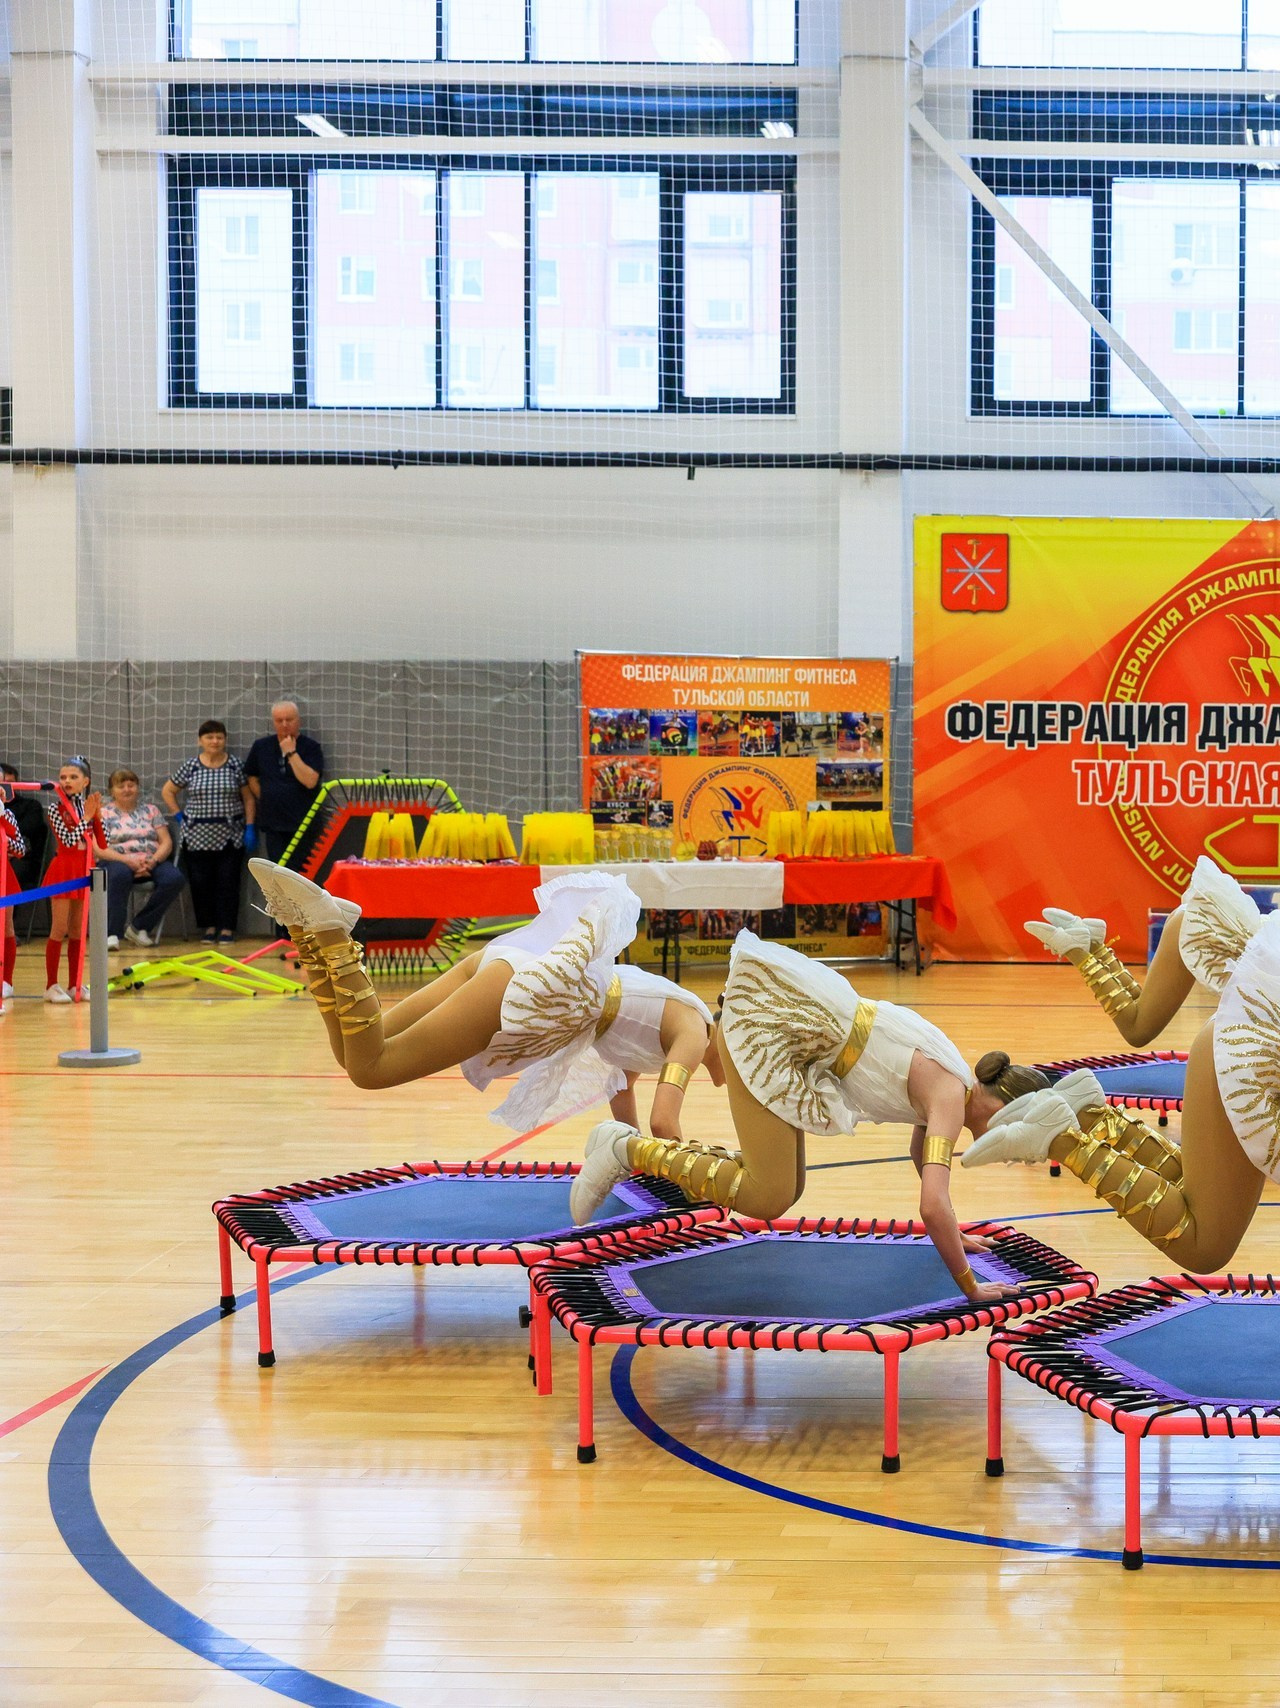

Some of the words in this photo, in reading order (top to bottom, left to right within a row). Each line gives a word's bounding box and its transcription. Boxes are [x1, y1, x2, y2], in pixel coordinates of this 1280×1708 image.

[622, 664, 708, 683] ФЕДЕРАЦИЯ
[711, 666, 791, 684] ДЖАМПИНГ
[794, 668, 857, 685] ФИТНЕСА
[1115, 607, 1184, 702] ДЕРАЦИЯ
[672, 687, 744, 706] ТУЛЬСКОЙ
[748, 690, 809, 707] ОБЛАСТИ
[946, 701, 1187, 750] ФЕДЕРАЦИЯ
[682, 777, 708, 819] ФЕДЕРАЦИЯ
[708, 765, 752, 780] ДЖАМПИНГ
[753, 768, 783, 791] ФИТНЕСА
